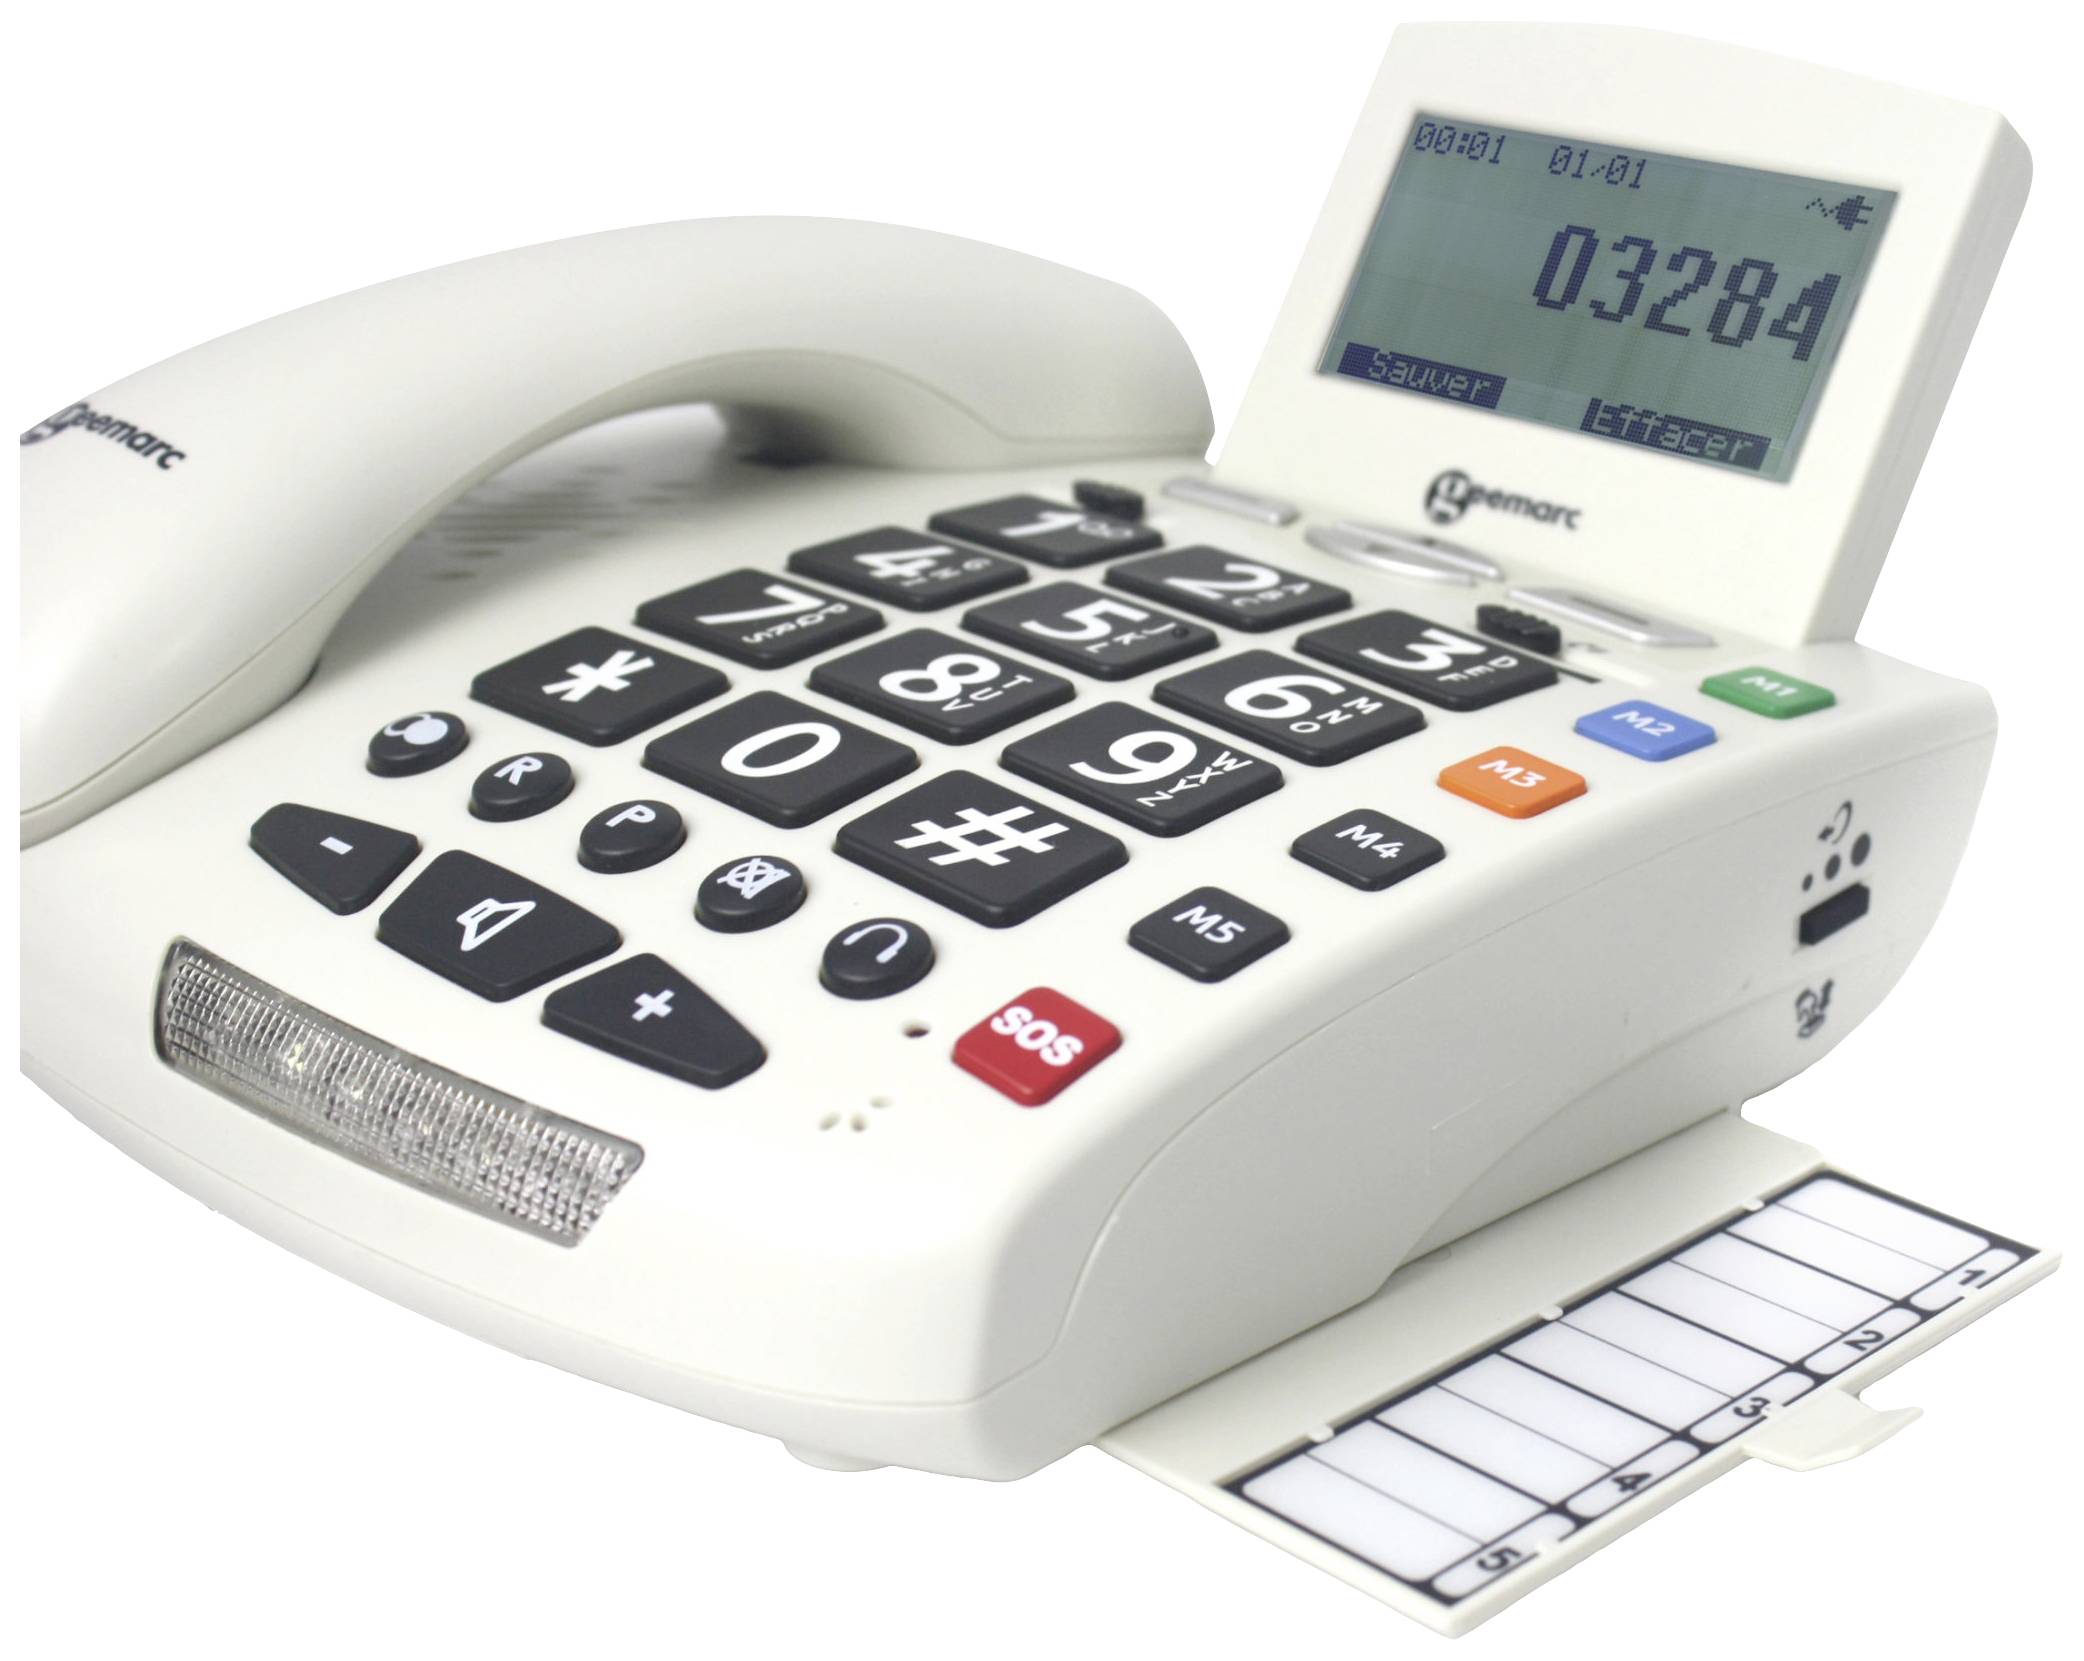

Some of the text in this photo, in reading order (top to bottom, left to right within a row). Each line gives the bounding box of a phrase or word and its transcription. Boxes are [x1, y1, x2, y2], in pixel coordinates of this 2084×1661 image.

[1413, 123, 1647, 190] 00:01 01/01
[1532, 225, 1842, 361] 03284
[1367, 350, 1752, 462] Sauver Effacer
[1000, 511, 1087, 538] 1
[853, 546, 954, 579] 4
[1163, 563, 1281, 600] 2
[696, 584, 825, 625] 7
[1021, 599, 1150, 641] 5
[1359, 628, 1487, 671] 3
[879, 653, 1001, 702] 8
[1225, 674, 1345, 718] 6
[1741, 675, 1798, 697] M1
[1612, 710, 1676, 737] M2
[721, 721, 841, 777] 0
[1069, 731, 1198, 784] 9
[494, 756, 543, 786] R
[1478, 759, 1547, 789] M3
[606, 804, 656, 827] P
[894, 805, 1070, 866] #
[1334, 824, 1405, 861] M4
[1172, 906, 1246, 945] M5
[990, 1005, 1084, 1067] SOS
[1958, 1269, 1987, 1286] 1
[1843, 1330, 1885, 1351] 2
[1733, 1396, 1771, 1418] 3
[1612, 1472, 1652, 1492] 4
[1476, 1547, 1522, 1571] 5
